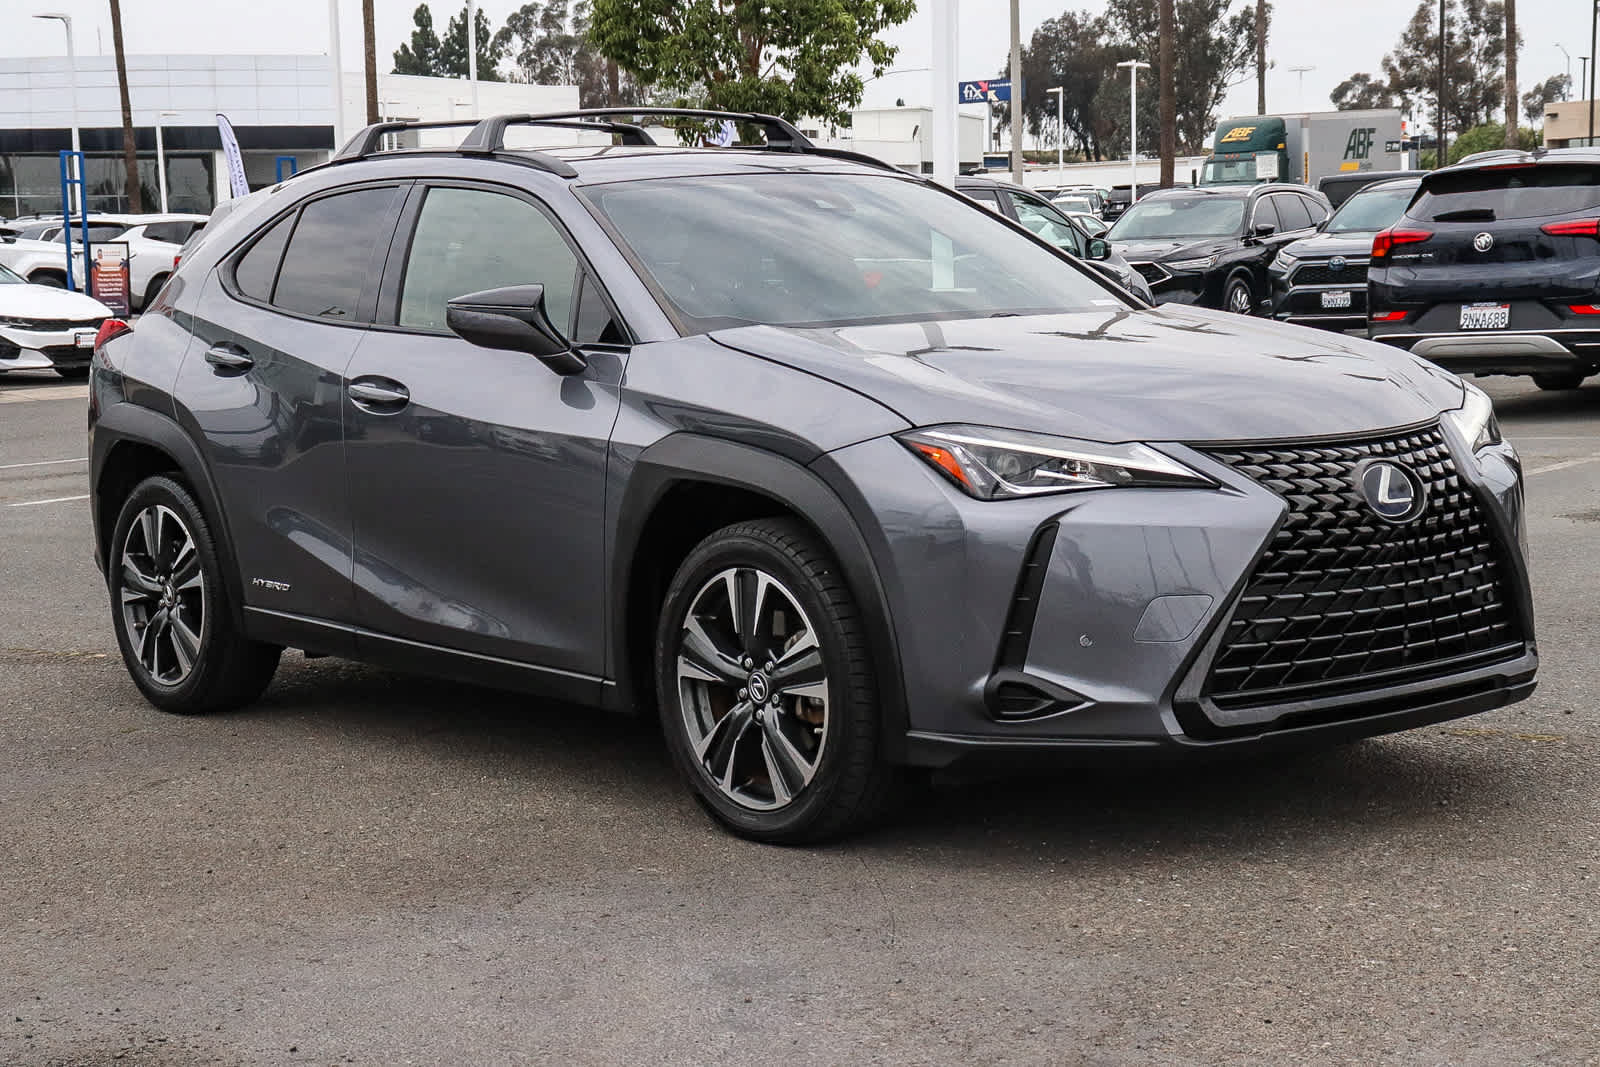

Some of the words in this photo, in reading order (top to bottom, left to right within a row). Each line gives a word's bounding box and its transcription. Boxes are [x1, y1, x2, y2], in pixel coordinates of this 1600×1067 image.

[963, 84, 985, 99] fix
[1223, 126, 1257, 139] ABF
[1343, 127, 1376, 160] ABF
[1461, 312, 1507, 327] 9NWA688
[252, 577, 290, 591] HYBRID
